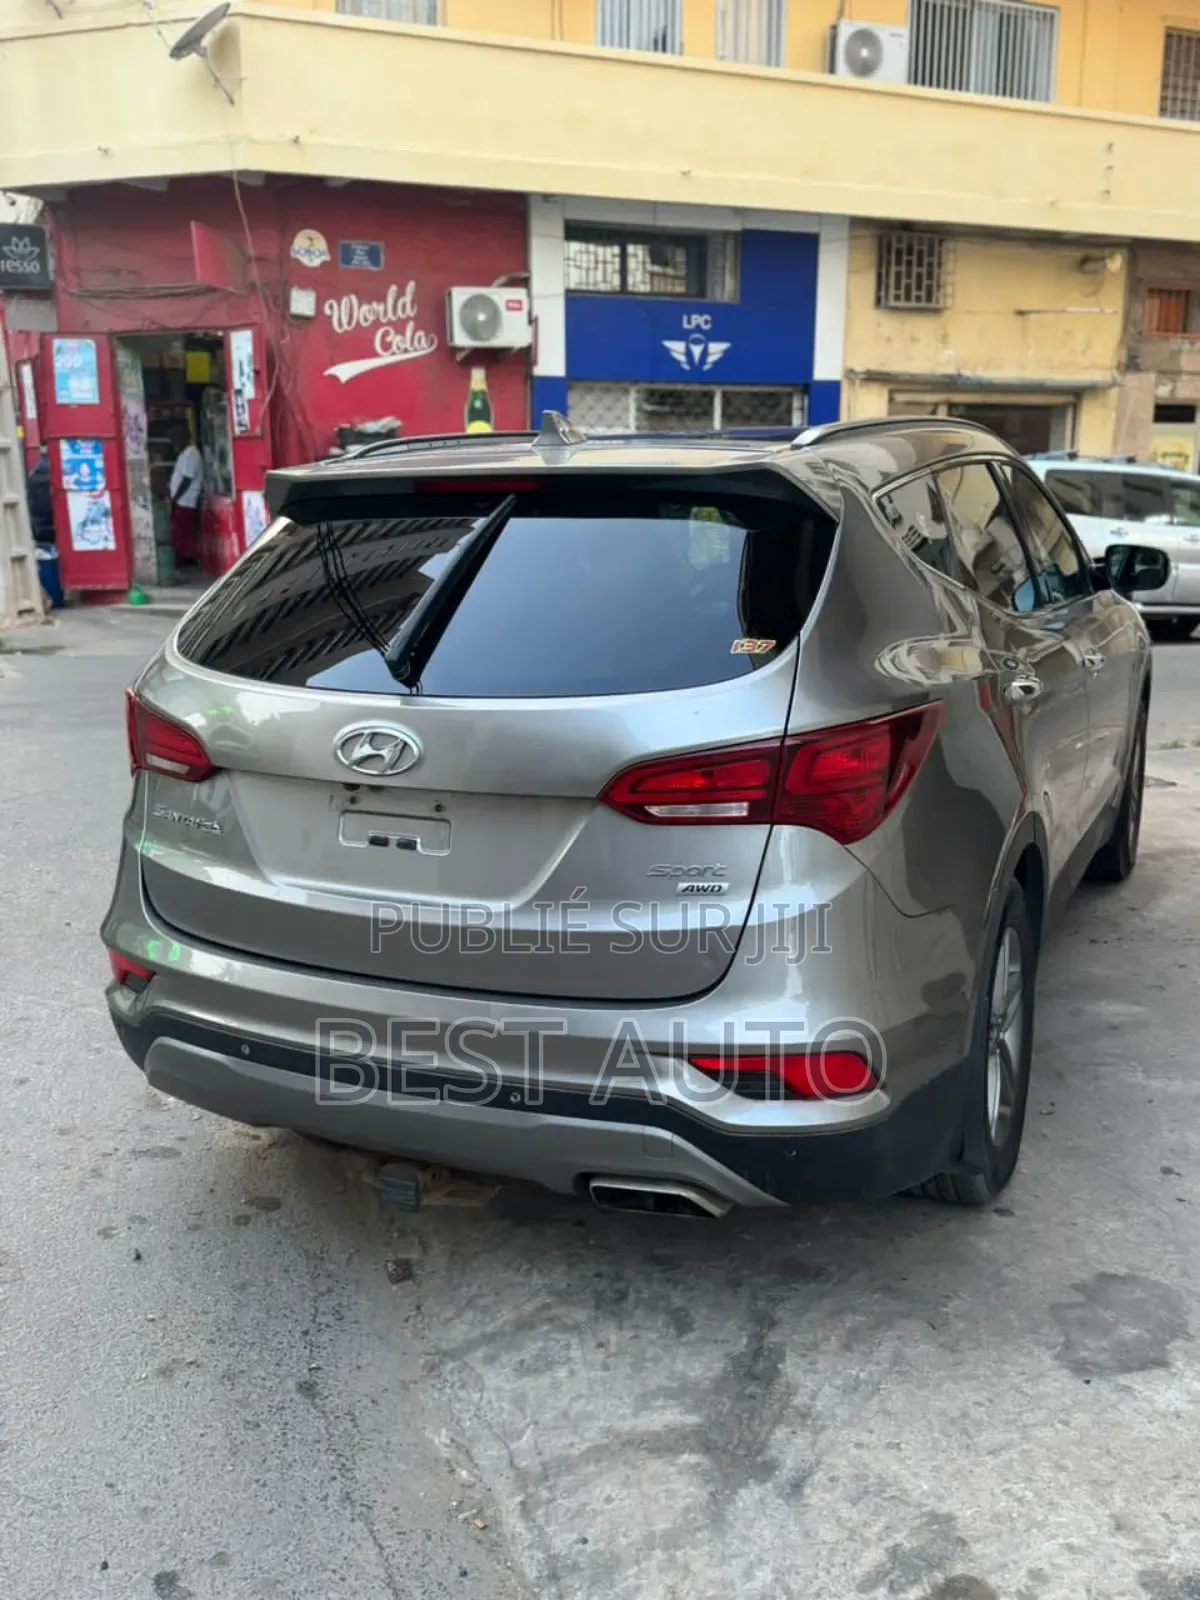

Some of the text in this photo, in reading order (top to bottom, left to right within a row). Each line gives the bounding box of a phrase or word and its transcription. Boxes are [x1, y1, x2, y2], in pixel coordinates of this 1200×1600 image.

[323, 280, 418, 334] World
[682, 313, 712, 330] LPC
[374, 320, 438, 356] Cola
[646, 863, 727, 880] Sport
[681, 884, 723, 893] AWD
